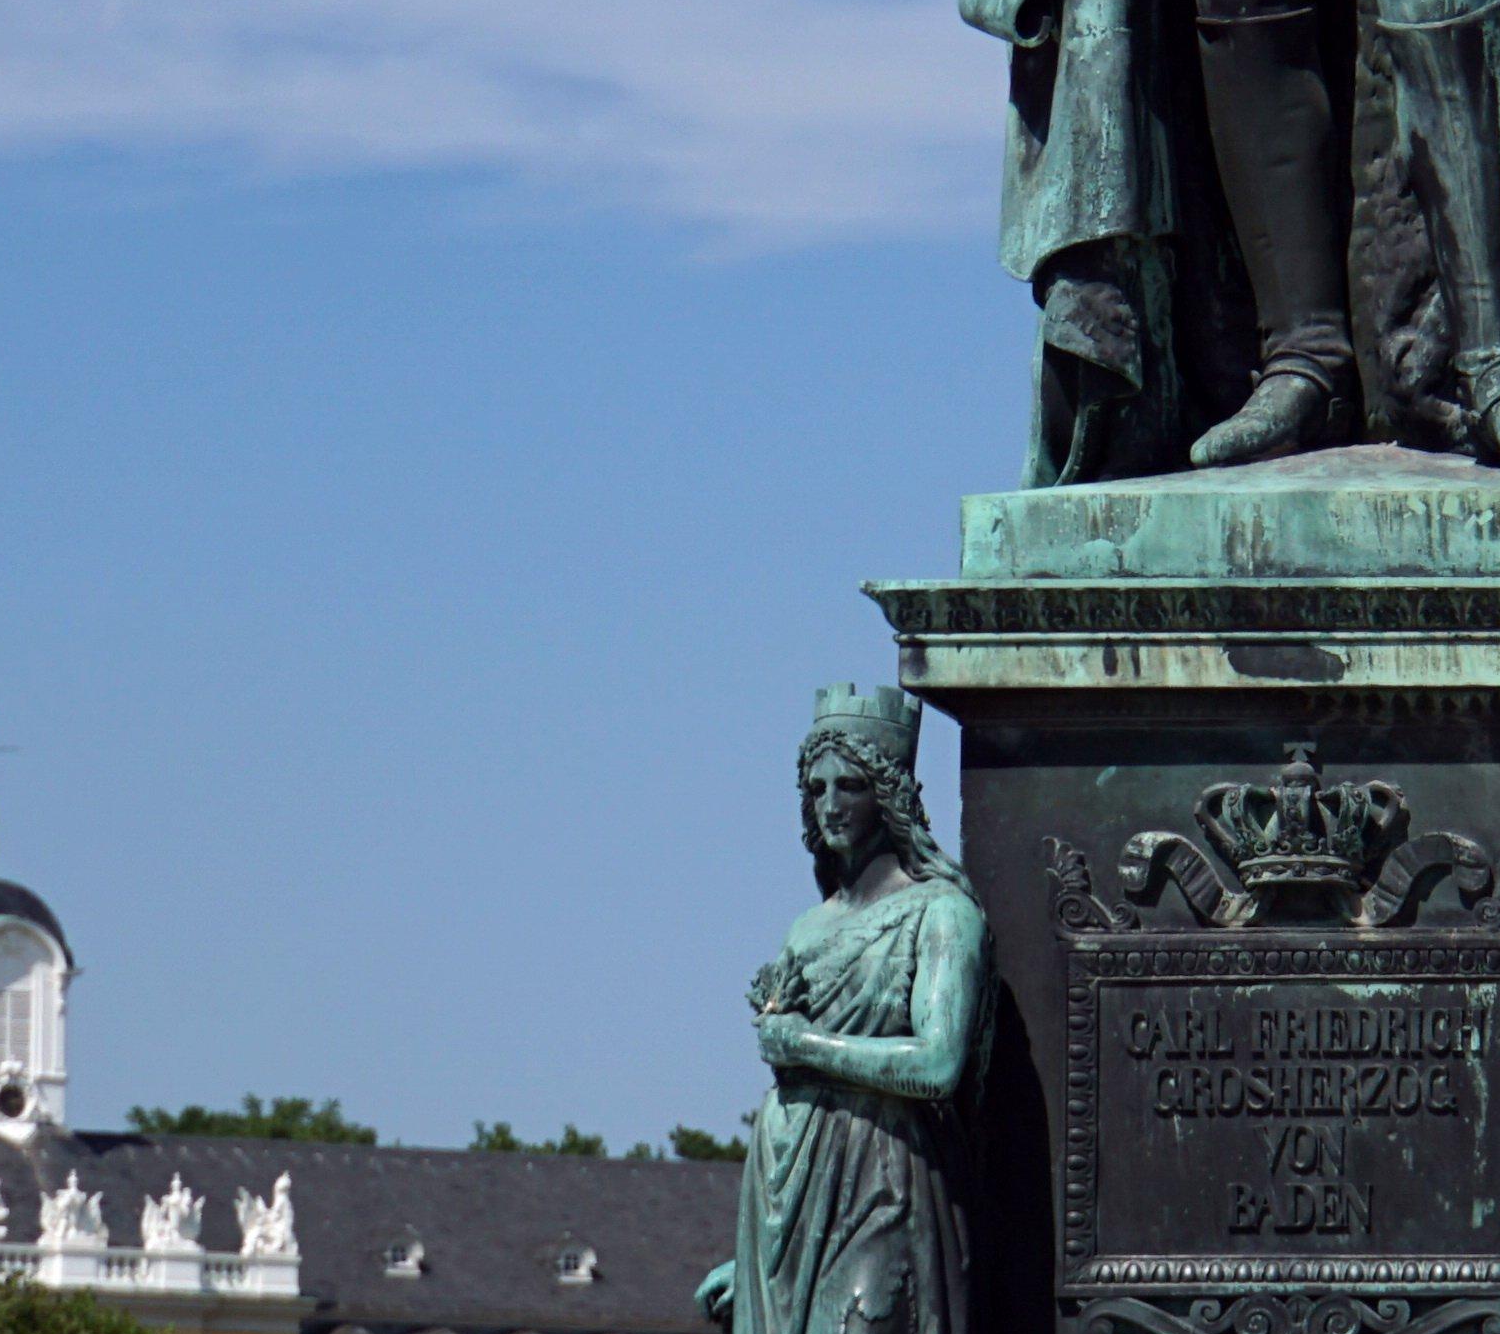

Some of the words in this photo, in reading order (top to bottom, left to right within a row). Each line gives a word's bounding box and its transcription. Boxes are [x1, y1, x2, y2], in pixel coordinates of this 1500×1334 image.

[1124, 1008, 1234, 1060] CARL
[1251, 1007, 1488, 1059] FRIEDRICH
[1153, 1066, 1459, 1117] GROSHERZOG
[1253, 1124, 1347, 1177] VON
[1227, 1183, 1375, 1235] BADEN
